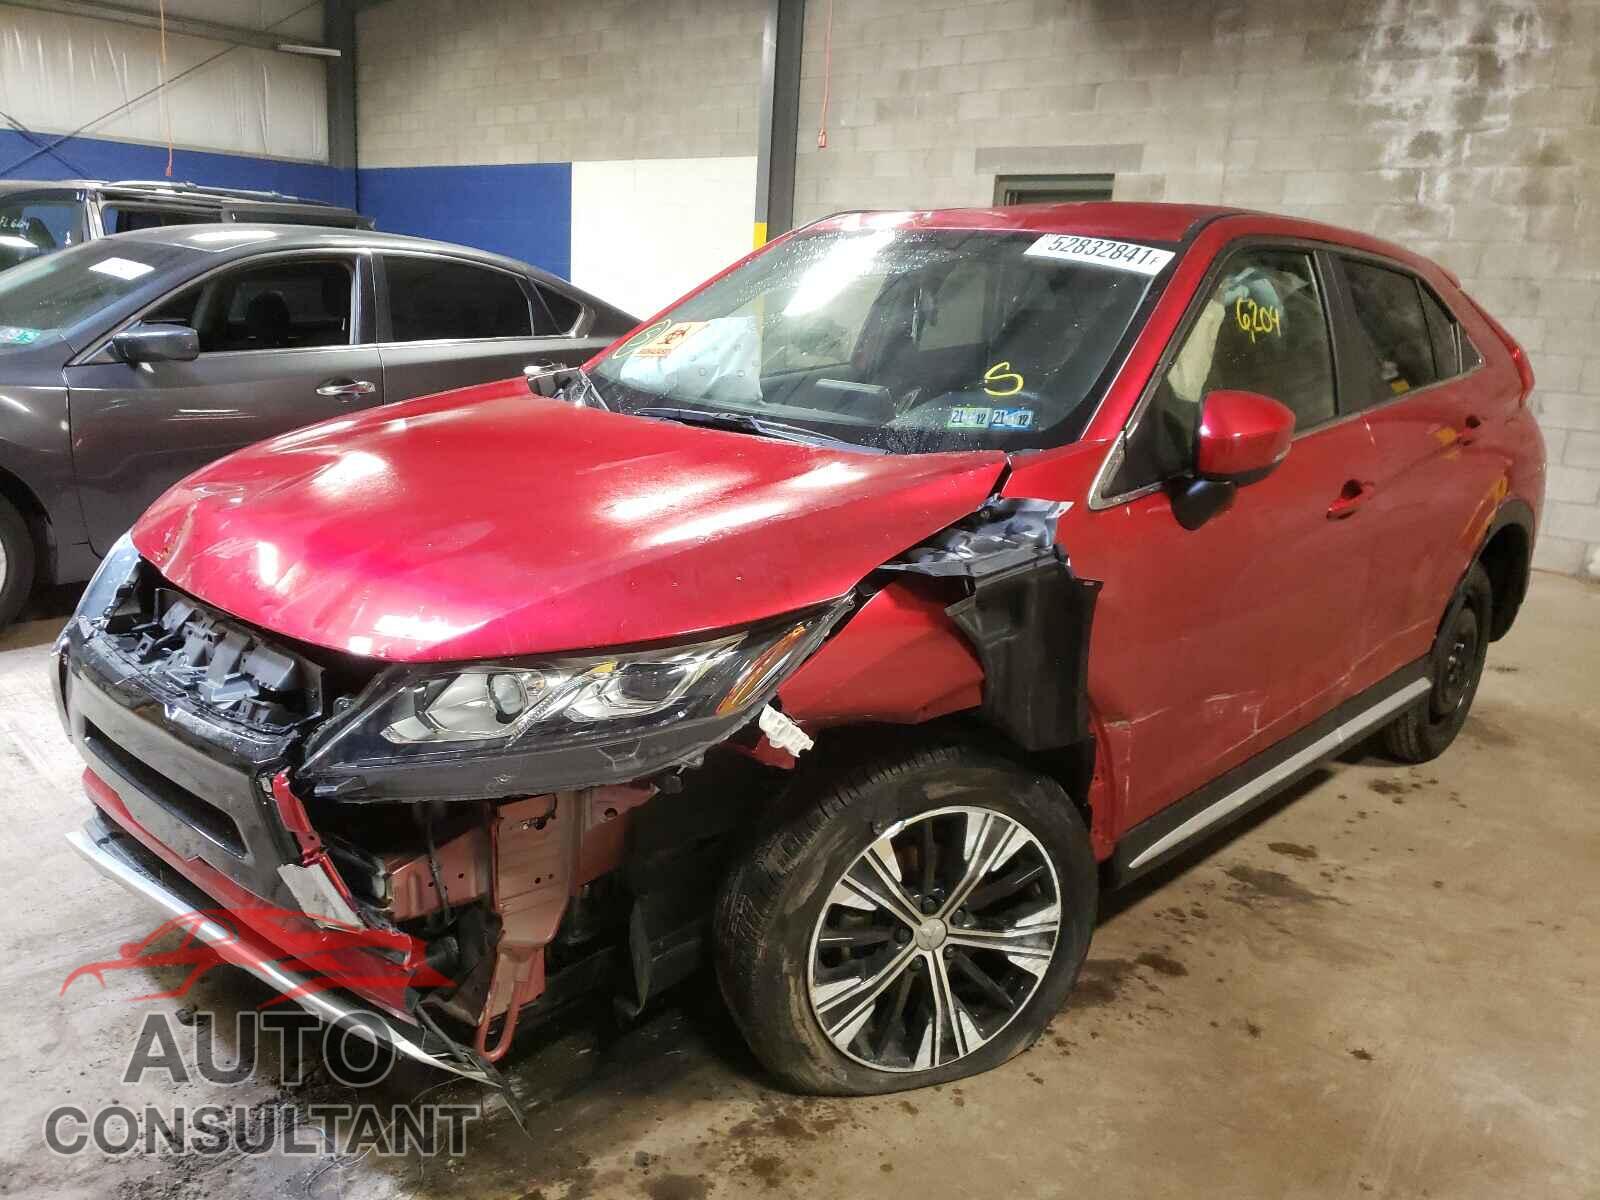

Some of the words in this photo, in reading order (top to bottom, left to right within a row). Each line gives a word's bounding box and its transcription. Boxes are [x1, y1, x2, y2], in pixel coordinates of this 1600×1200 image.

[1047, 236, 1152, 265] 52832841
[951, 410, 964, 424] 21
[976, 413, 987, 425] 12
[991, 410, 1007, 424] 21
[1018, 413, 1029, 425] 12
